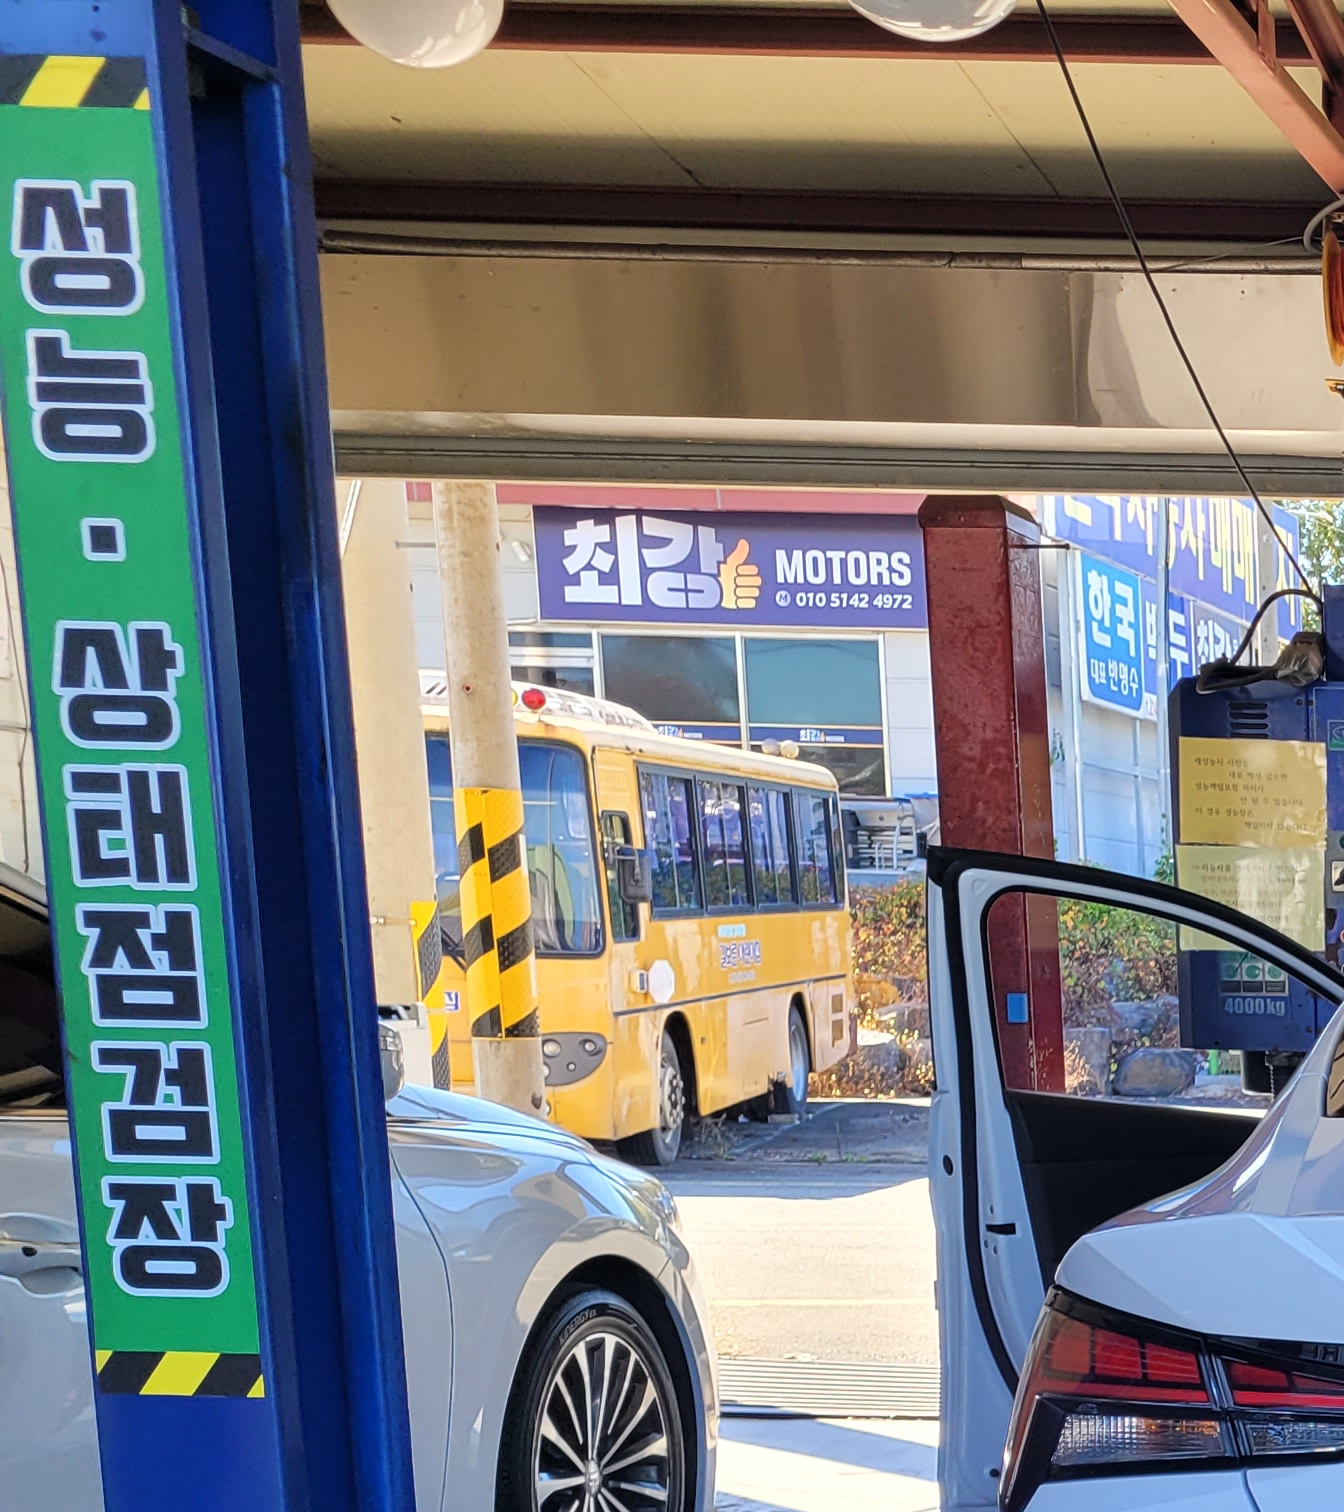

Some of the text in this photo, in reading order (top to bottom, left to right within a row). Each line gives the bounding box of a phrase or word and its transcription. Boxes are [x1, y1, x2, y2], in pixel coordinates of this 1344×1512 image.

[12, 179, 154, 461] 성능
[562, 514, 912, 609] 최강 MOTORS
[795, 592, 827, 607] 010
[829, 592, 869, 608] 5142
[872, 593, 913, 609] 4972
[1087, 569, 1136, 658] 한국
[1090, 658, 1106, 685] 대표
